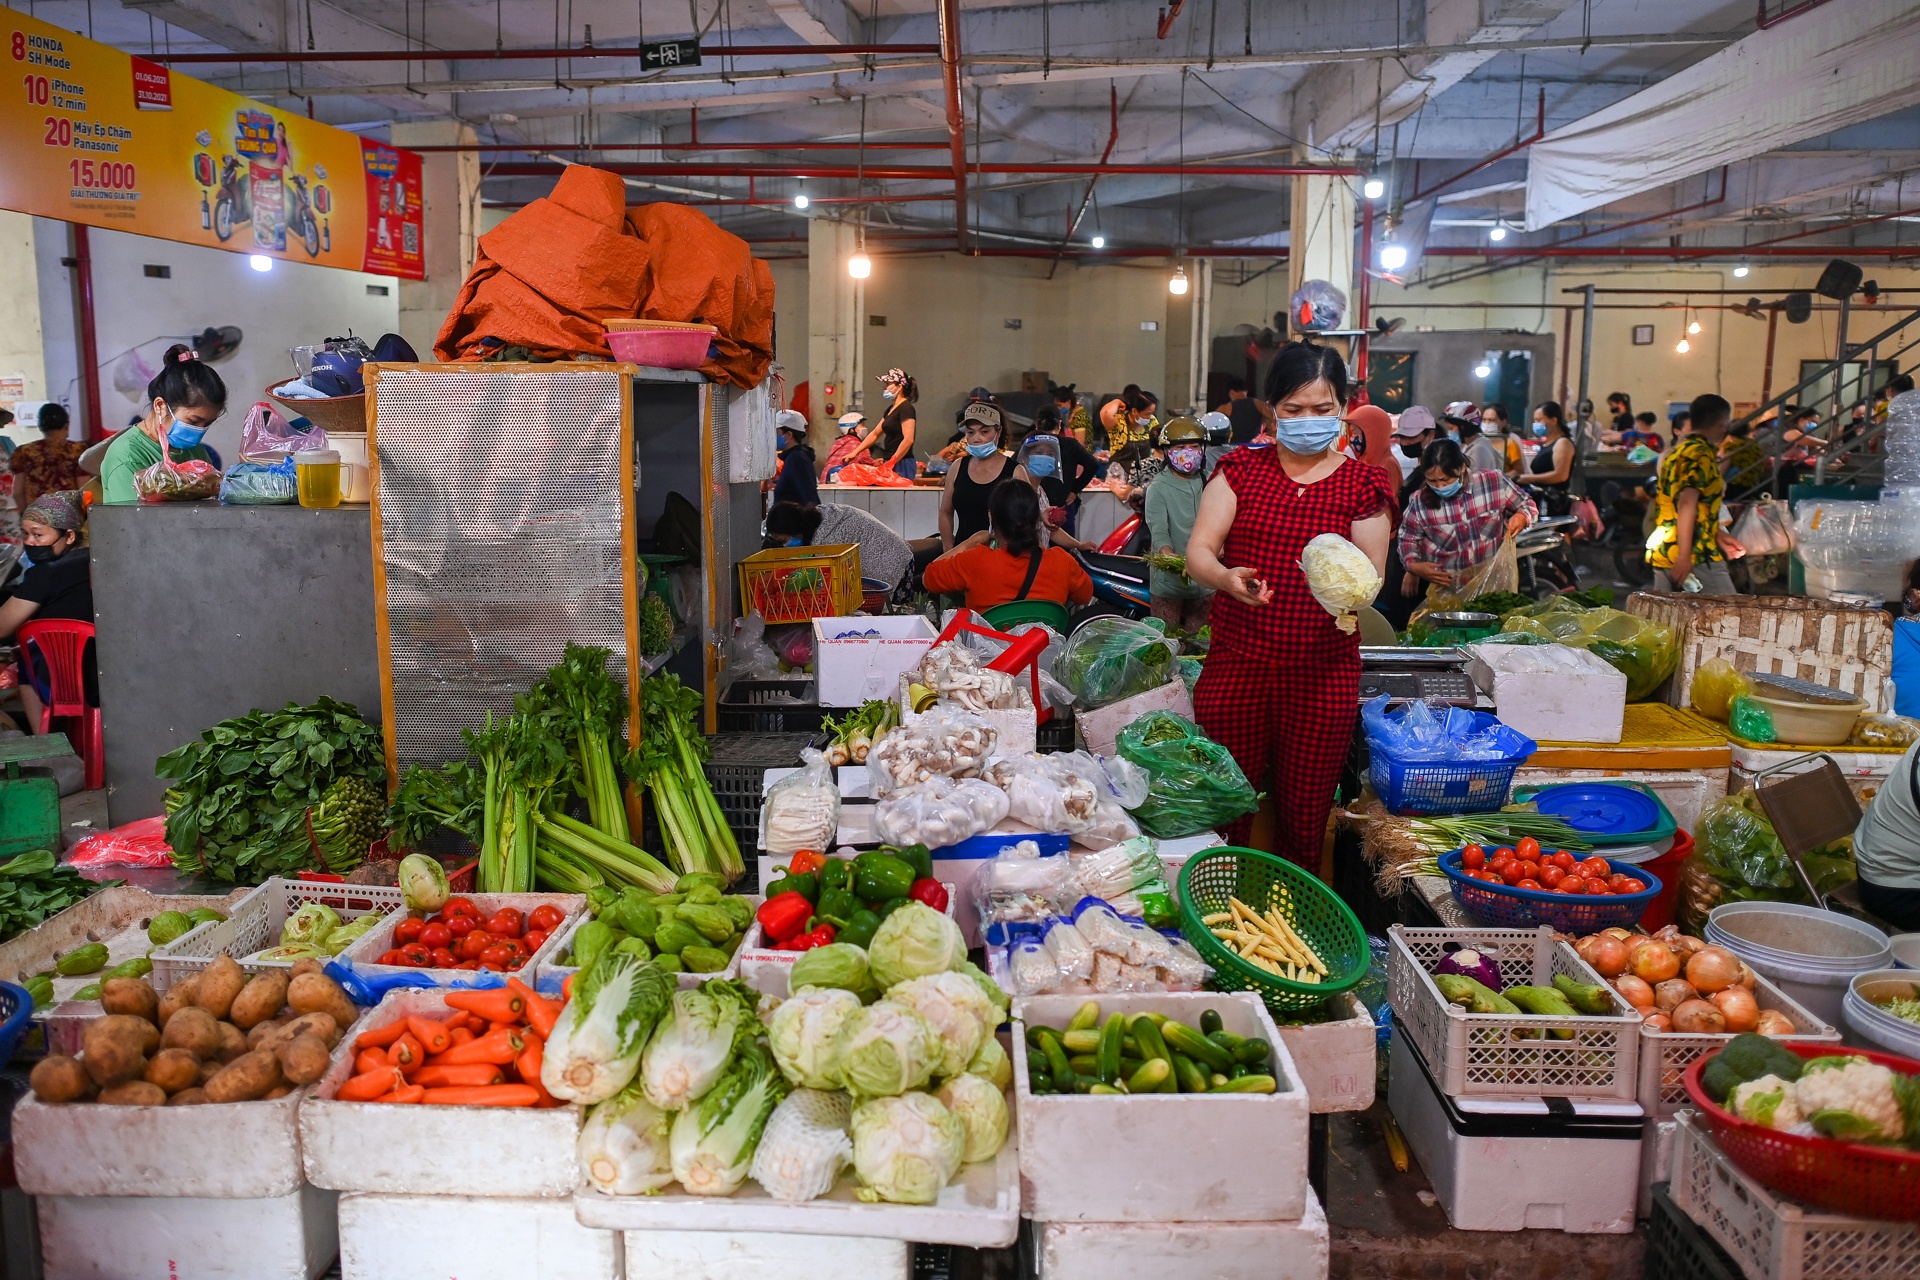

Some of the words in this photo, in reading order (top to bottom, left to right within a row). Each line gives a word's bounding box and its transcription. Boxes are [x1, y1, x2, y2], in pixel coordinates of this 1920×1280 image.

[11, 31, 25, 60] 8
[28, 34, 64, 53] HONDA
[28, 52, 42, 66] SH
[45, 55, 71, 70] Mode
[135, 72, 166, 85] 01.06.2021
[23, 73, 49, 106] 10
[51, 79, 84, 96] iPhone
[138, 90, 167, 102] 31.10.2021
[51, 95, 63, 108] 12
[66, 99, 86, 112] mini
[44, 116, 71, 148] 20
[73, 121, 92, 136] Máy
[73, 137, 119, 152] Panasonic
[69, 157, 136, 190] 15.000
